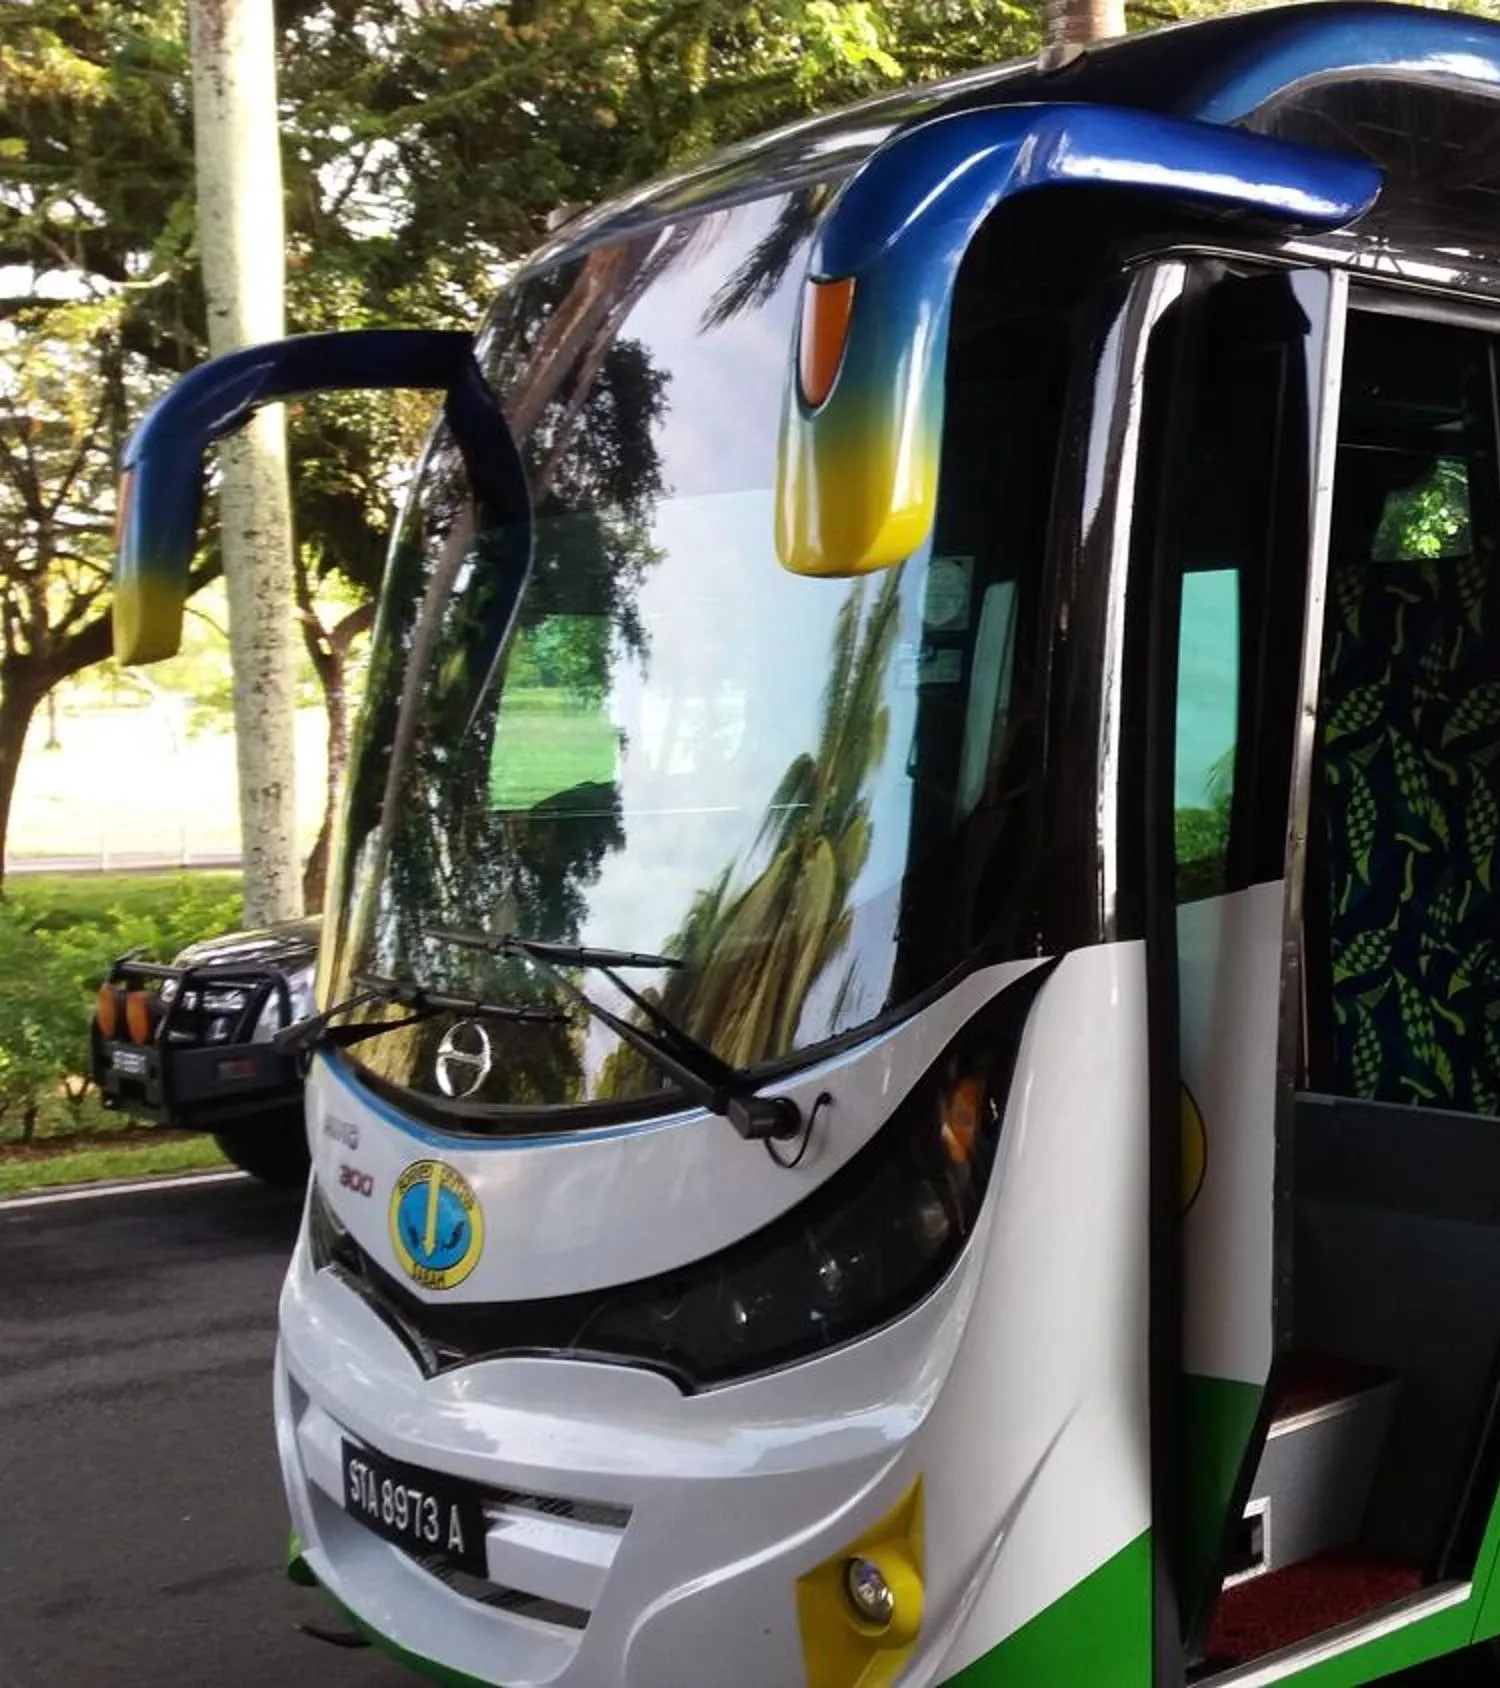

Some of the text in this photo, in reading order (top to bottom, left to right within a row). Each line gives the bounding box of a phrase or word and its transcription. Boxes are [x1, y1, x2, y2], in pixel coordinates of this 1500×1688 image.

[350, 1458, 465, 1554] STA 8973 A
